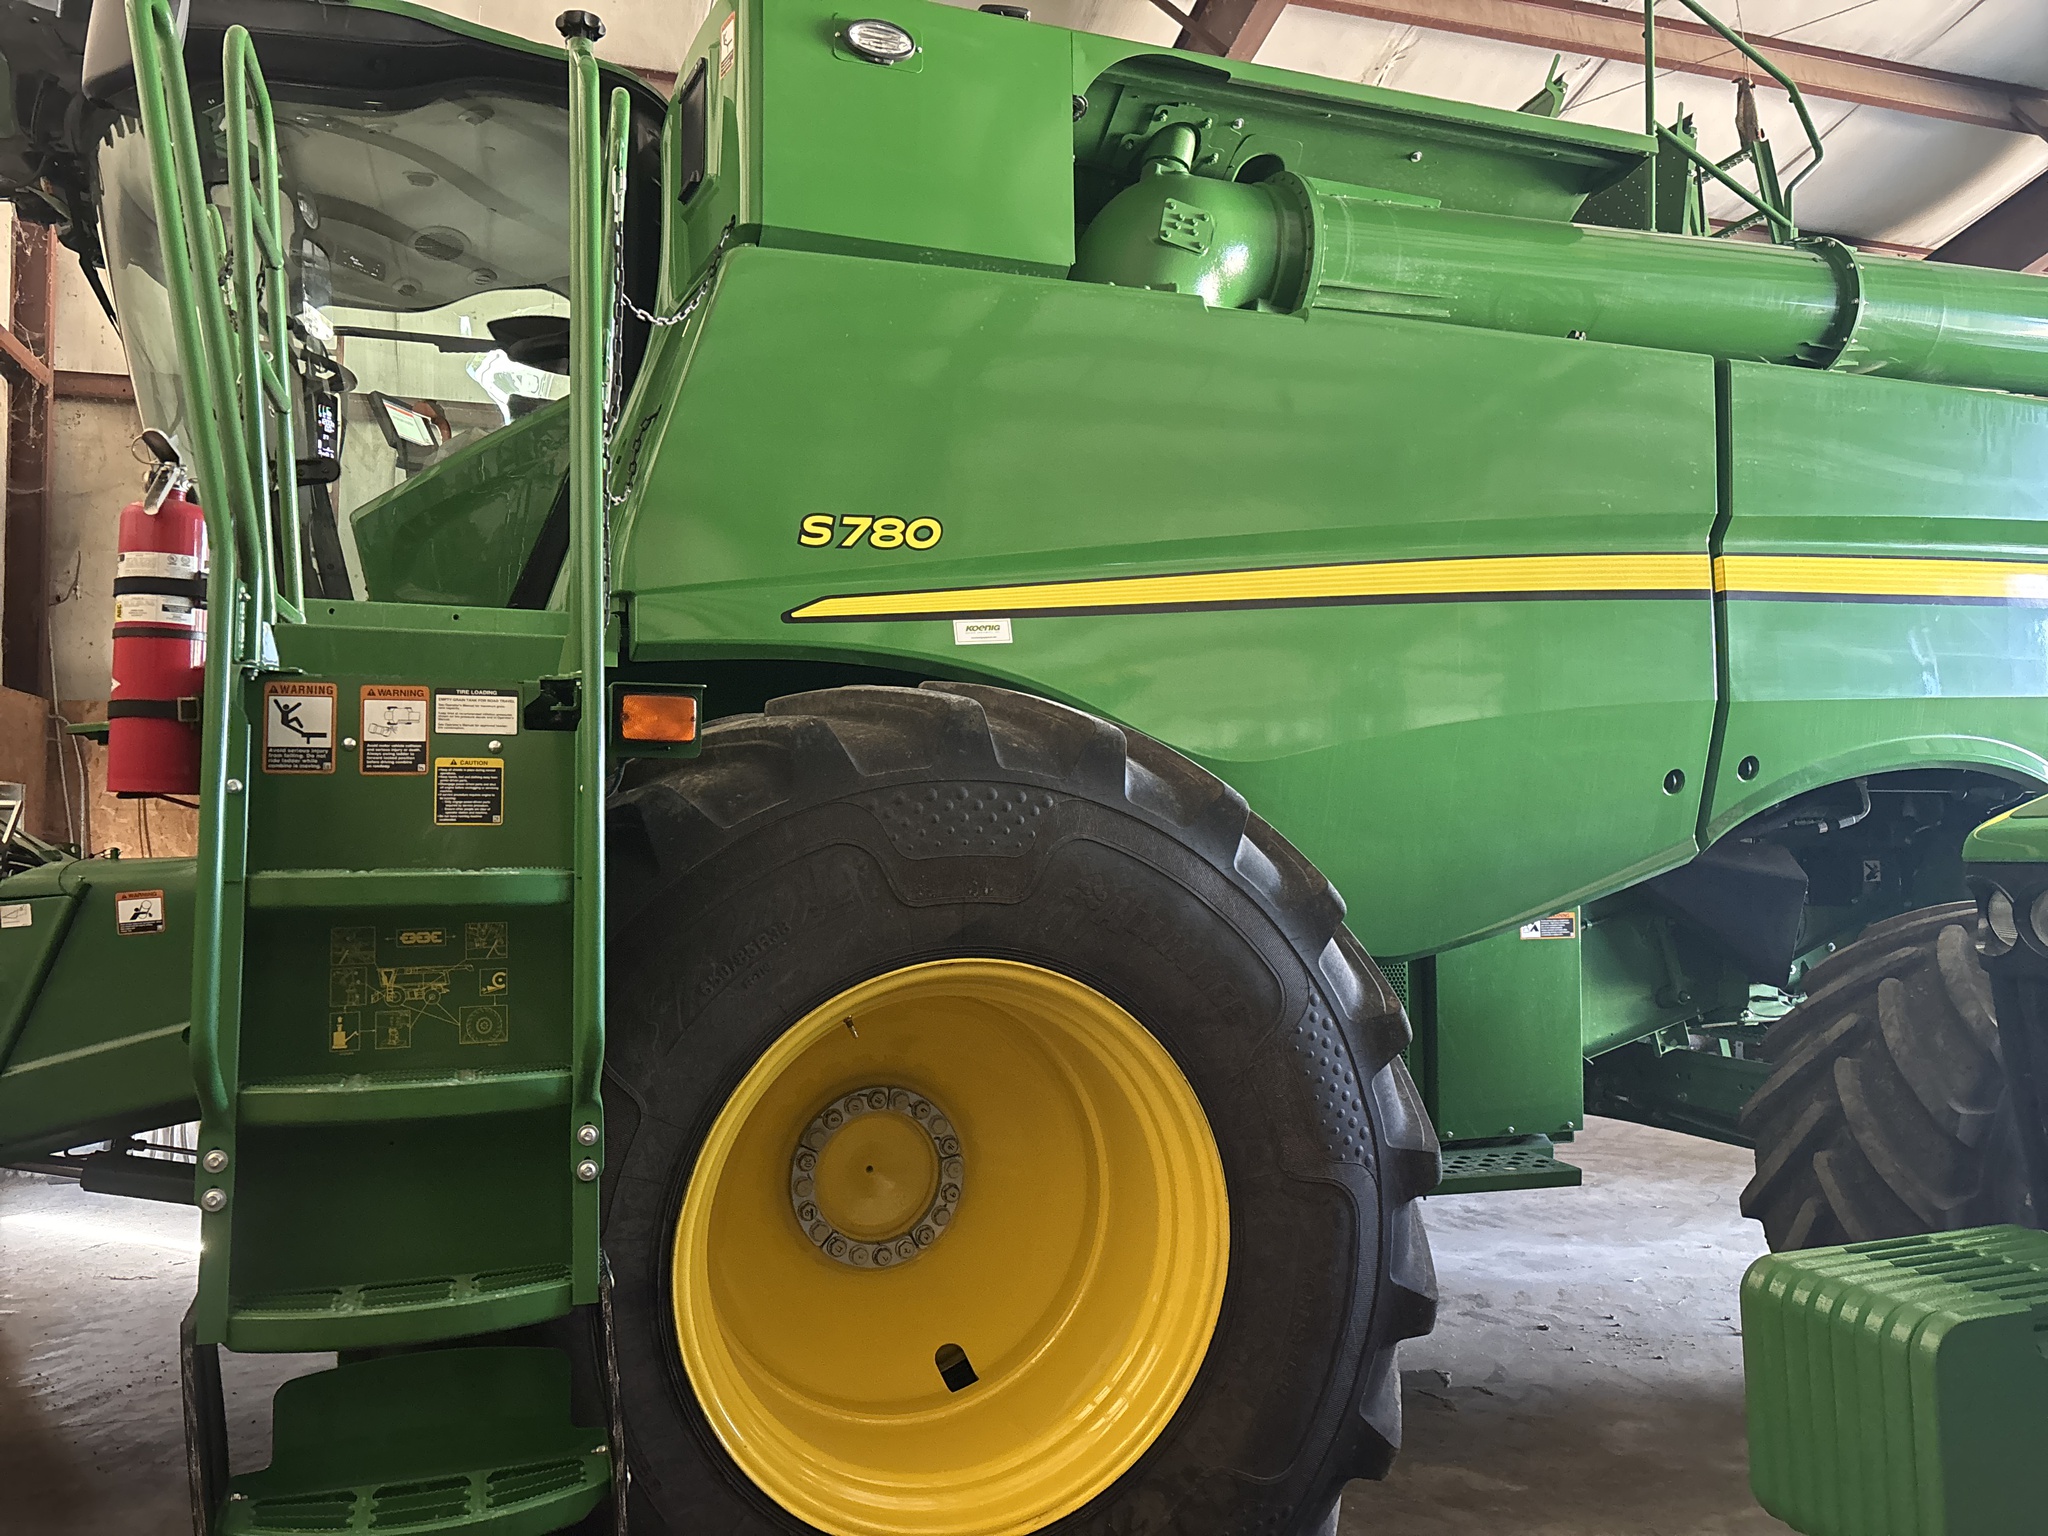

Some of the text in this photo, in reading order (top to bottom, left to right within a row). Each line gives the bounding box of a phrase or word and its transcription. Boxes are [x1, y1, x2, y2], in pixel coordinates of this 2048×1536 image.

[797, 513, 943, 550] S780
[279, 685, 333, 695] WARNING
[377, 689, 424, 697] WARNING
[128, 891, 158, 899] WARNING
